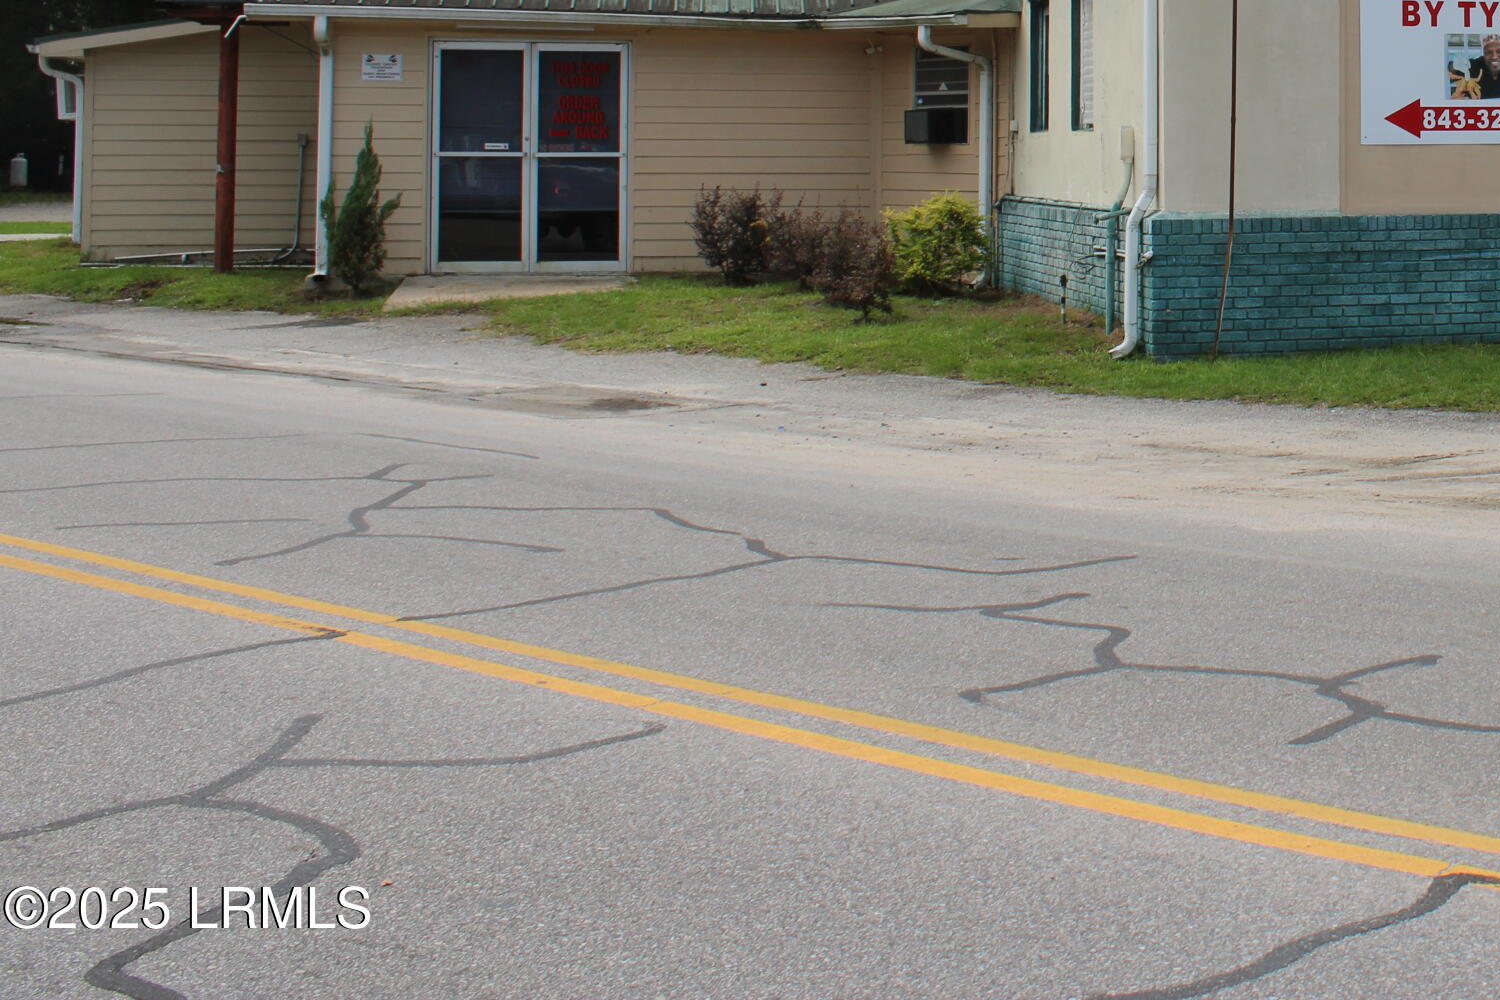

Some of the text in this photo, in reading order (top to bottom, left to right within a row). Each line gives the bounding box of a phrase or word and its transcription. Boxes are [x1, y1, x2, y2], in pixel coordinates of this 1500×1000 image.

[1402, 0, 1444, 27] BY
[558, 95, 601, 109] ORDER
[552, 111, 606, 124] AROUND
[576, 125, 609, 139] BACK
